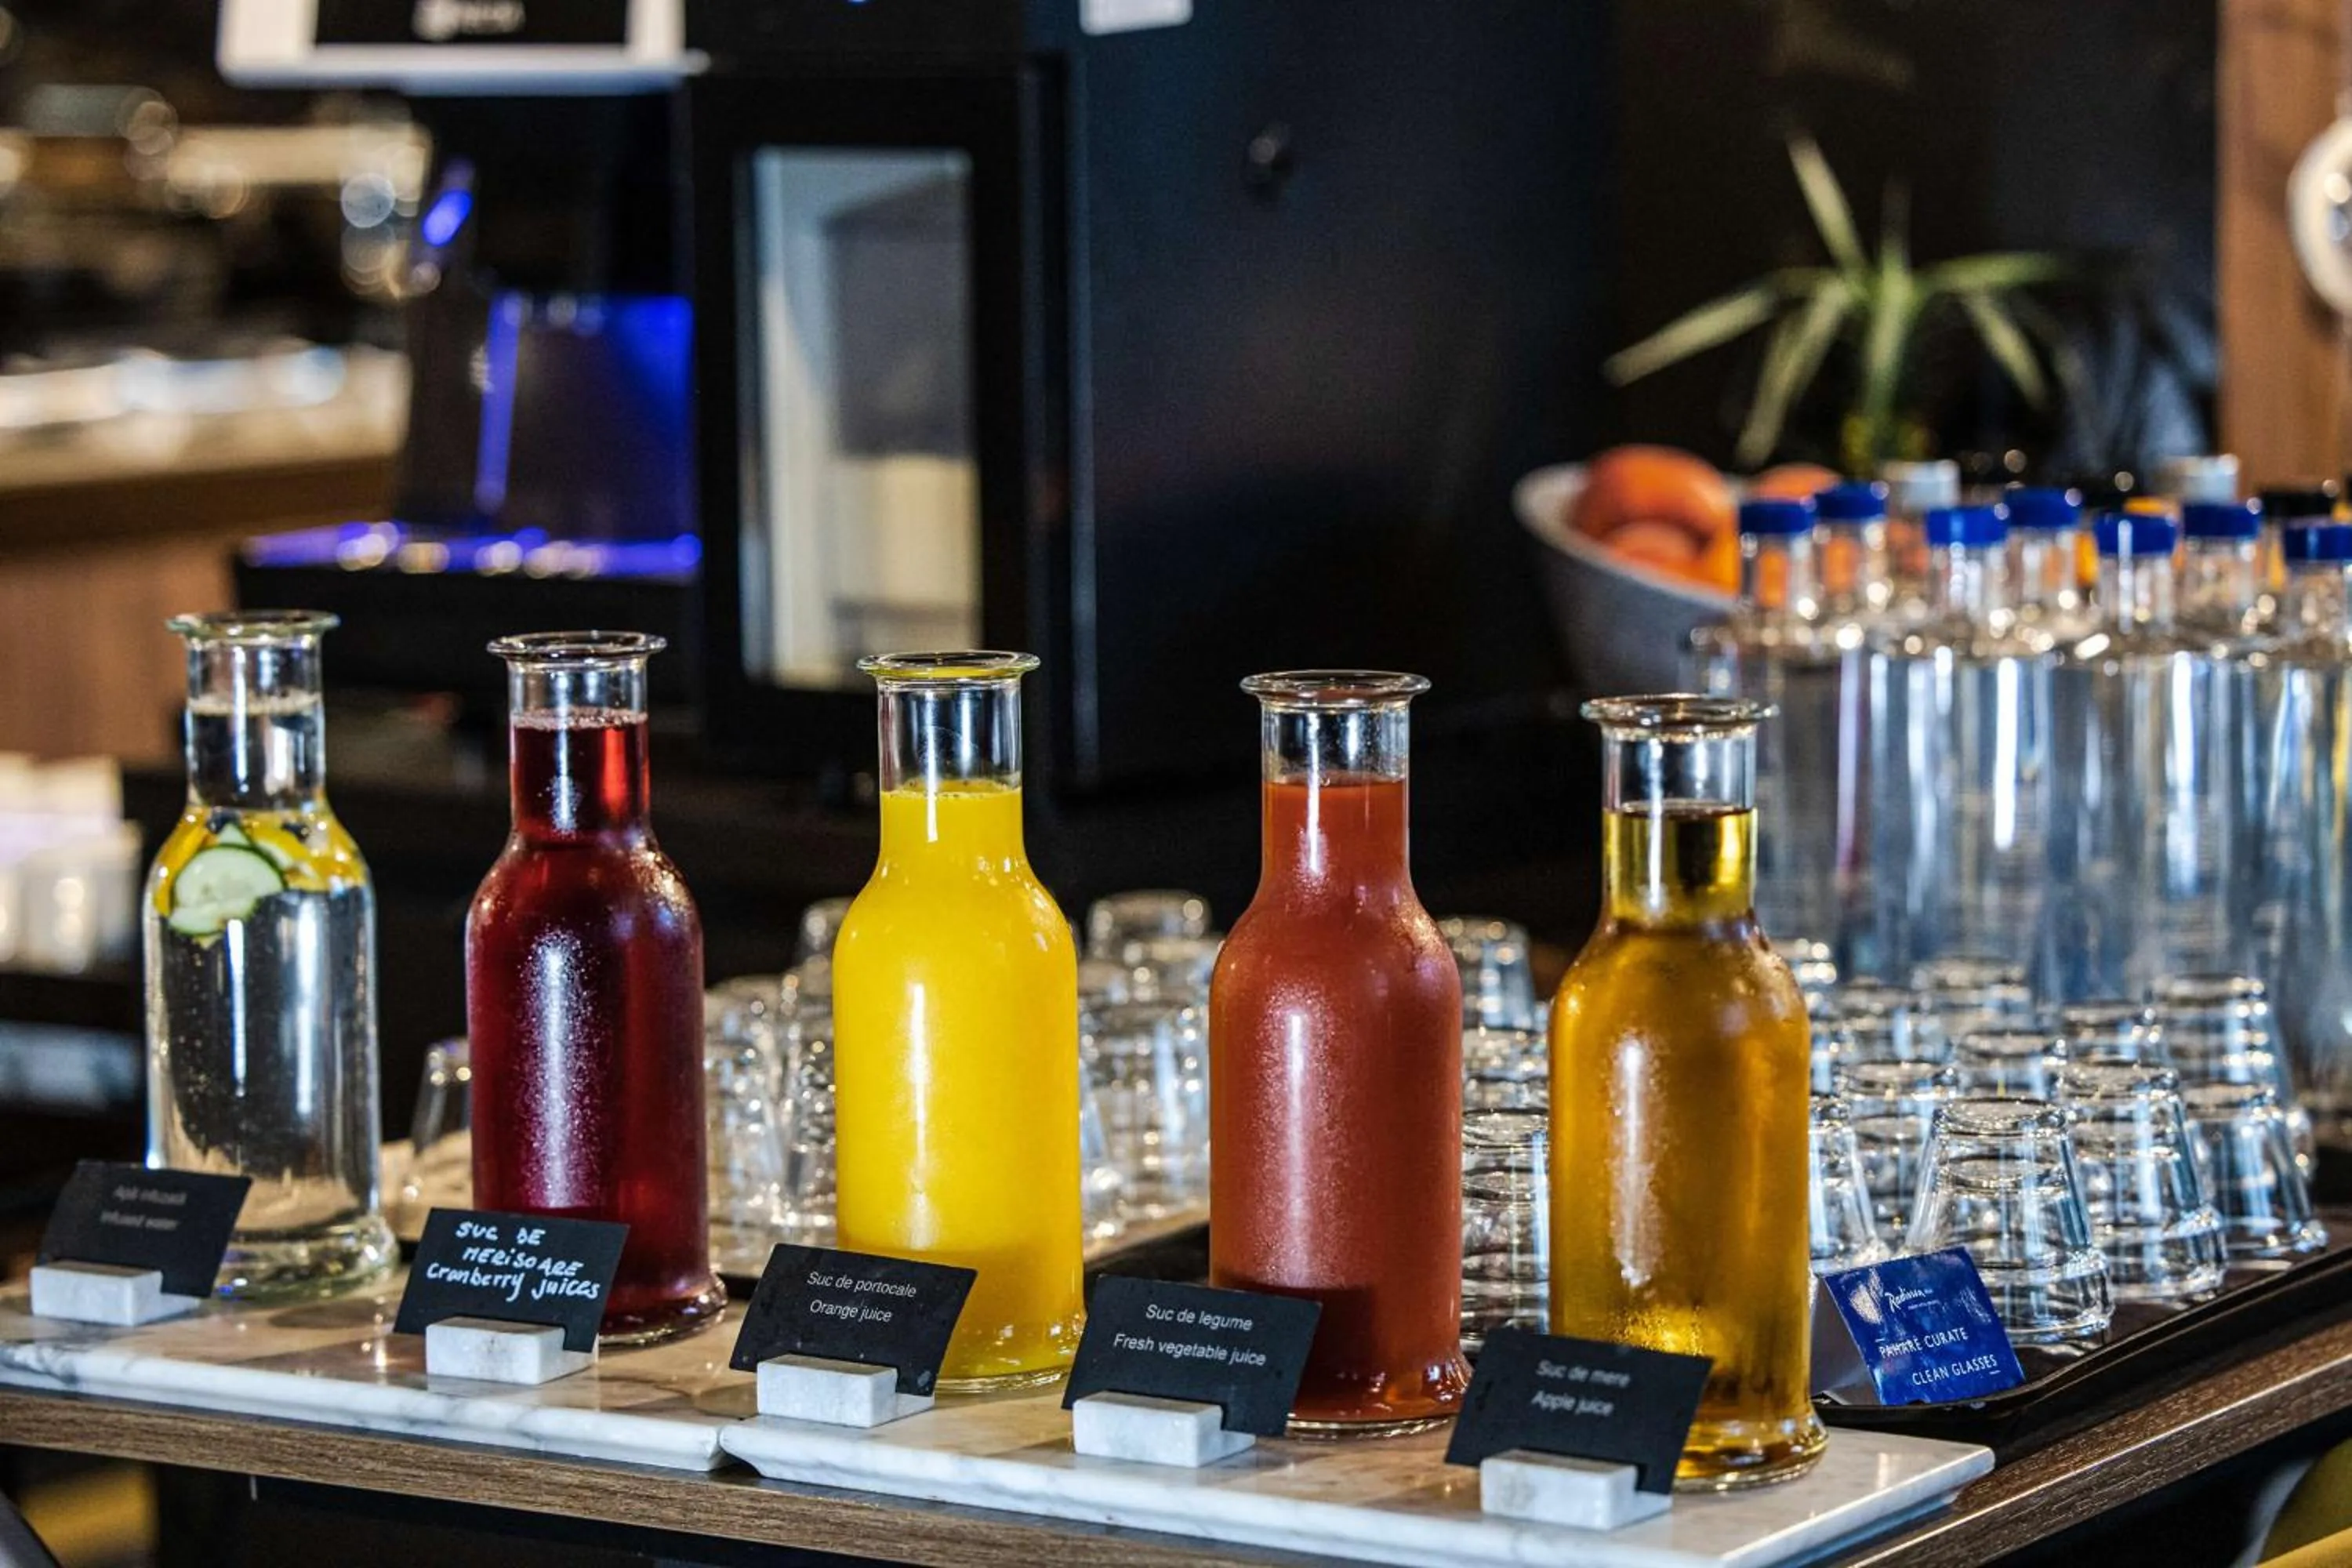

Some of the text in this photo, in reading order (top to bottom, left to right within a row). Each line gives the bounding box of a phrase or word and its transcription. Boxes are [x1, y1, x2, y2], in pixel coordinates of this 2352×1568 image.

[456, 1221, 545, 1245] SUC DE
[426, 1263, 601, 1301] Cranberry juices
[808, 1271, 916, 1298] Suc de portocale
[810, 1299, 893, 1323] Orange juice
[1145, 1304, 1253, 1331] Suc de legume
[1113, 1334, 1267, 1367] Fresh vegetable juice
[1924, 1327, 1969, 1348] CURATE
[1536, 1360, 1631, 1388] Suc de mere
[1912, 1354, 1998, 1385] CLEAN GLASSES
[1531, 1390, 1615, 1416] Apple juice
